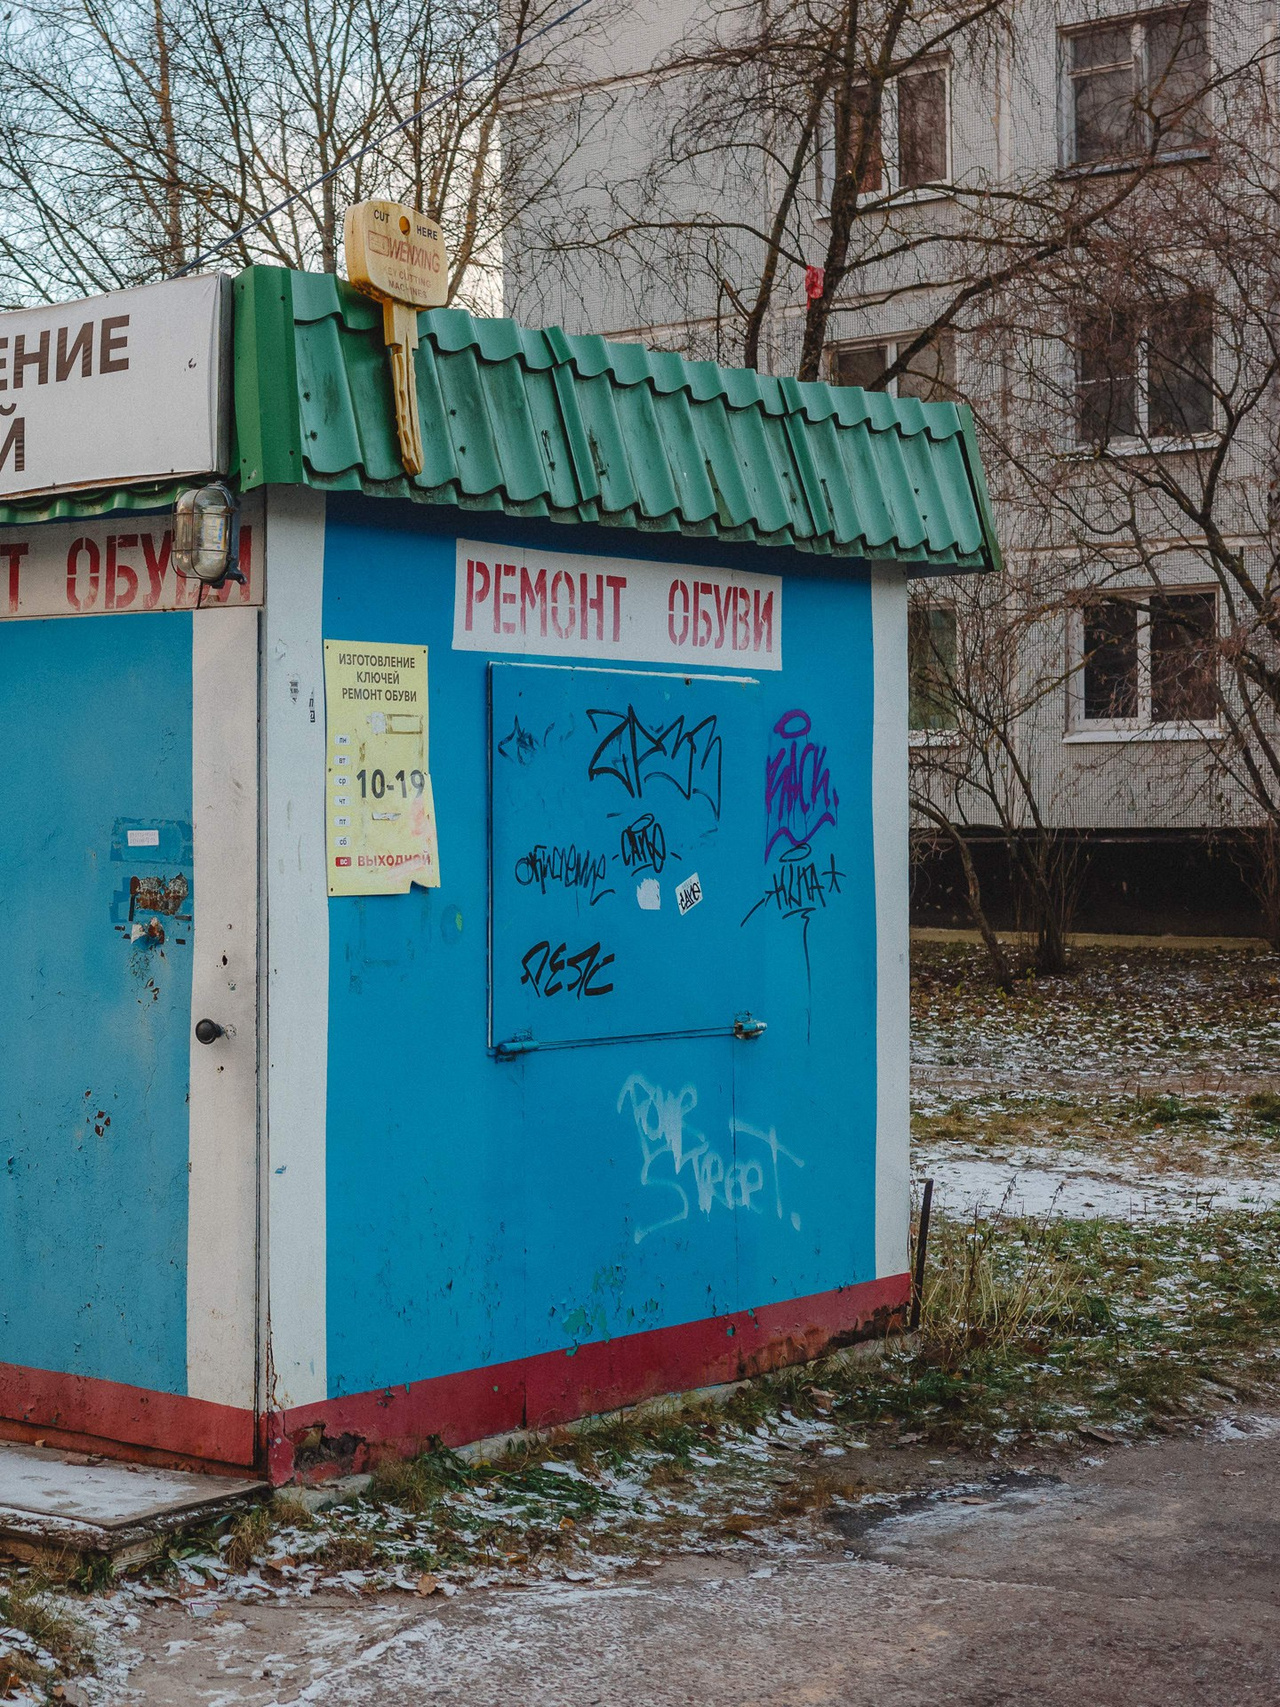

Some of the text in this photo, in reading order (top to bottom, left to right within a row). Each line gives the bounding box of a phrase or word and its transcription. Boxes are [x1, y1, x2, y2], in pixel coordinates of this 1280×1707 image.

[373, 209, 438, 241] CUT HERE
[387, 237, 440, 274] WENXING
[464, 558, 774, 653] РЕМОНТ ОБУВИ
[338, 653, 416, 669] ИЗГОТОВЛЕНИЕ
[356, 670, 400, 685] КЛЮЧЕЙ
[342, 687, 417, 703] РЕМОНТ ОБУВИ
[356, 768, 426, 799] 10-19
